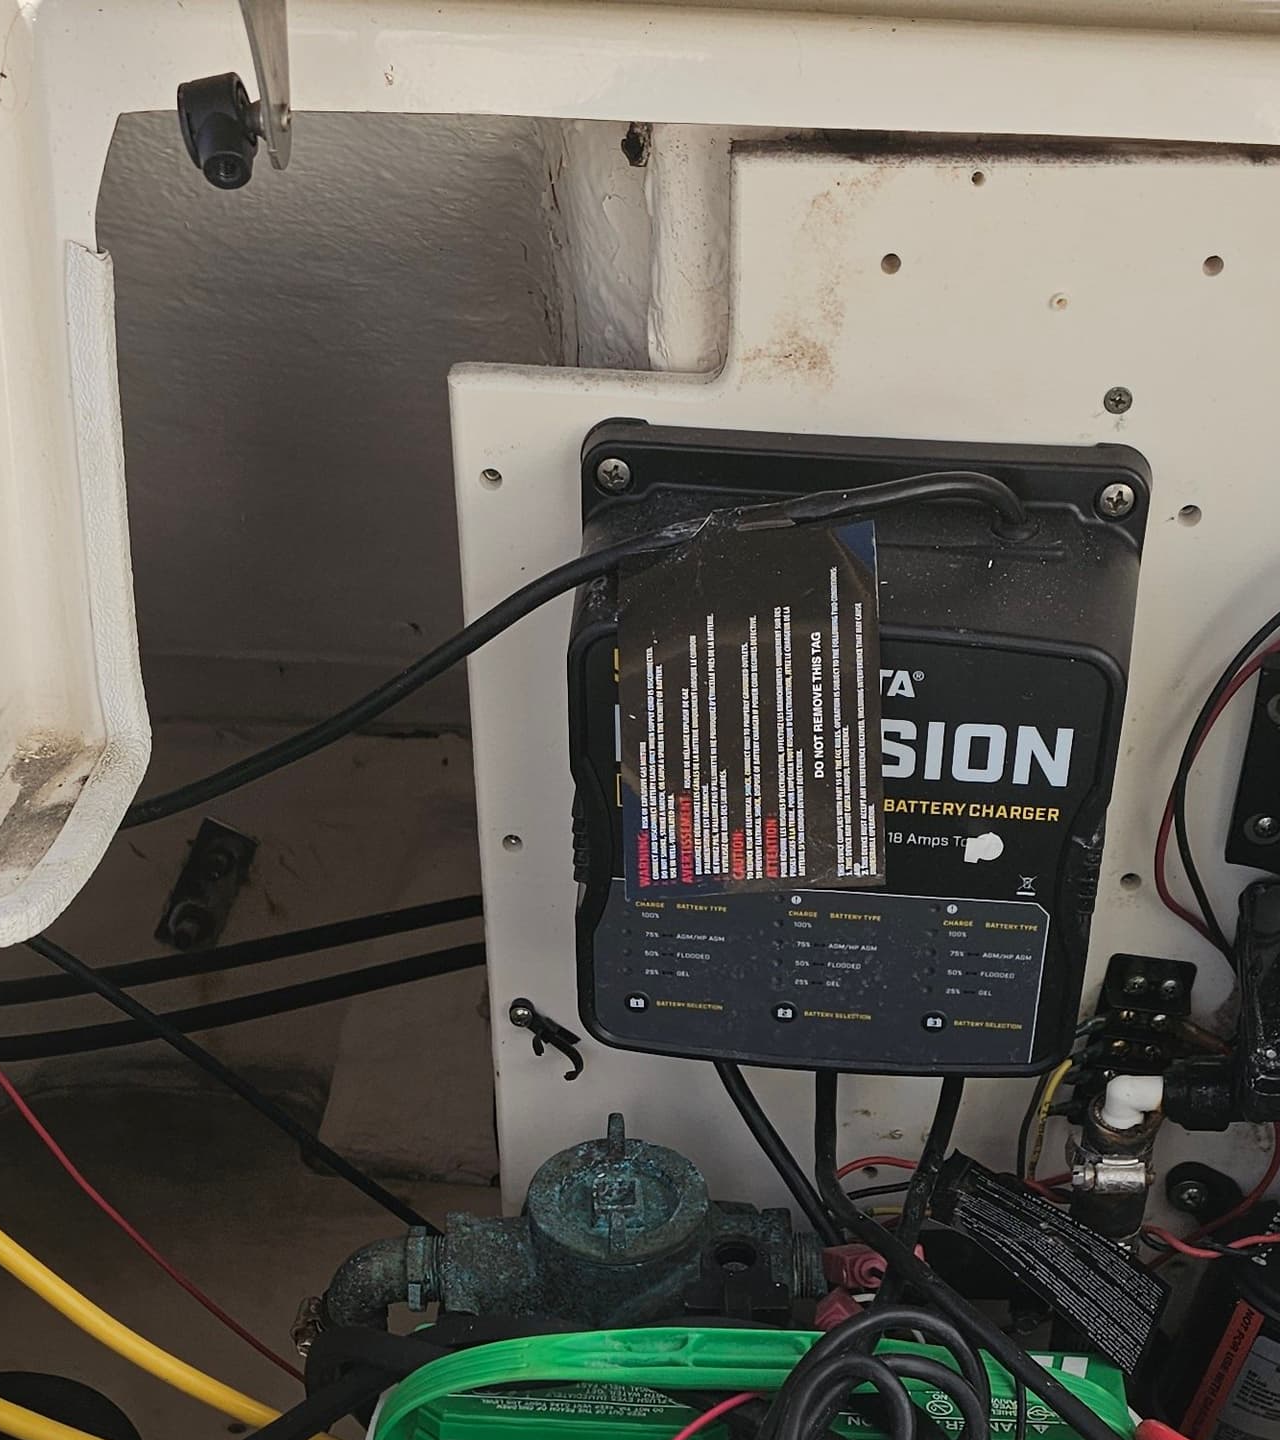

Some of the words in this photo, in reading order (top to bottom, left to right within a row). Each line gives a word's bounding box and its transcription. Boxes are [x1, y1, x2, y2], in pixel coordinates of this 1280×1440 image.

[810, 632, 822, 655] TAG
[811, 656, 822, 683] THIS
[811, 684, 823, 732] REMOVE
[814, 735, 824, 759] NOT
[814, 761, 824, 778] DO
[883, 799, 967, 816] BATTERY
[969, 803, 1060, 822] CHARGER
[888, 832, 903, 843] 18
[907, 832, 949, 848] Amps
[635, 901, 664, 909] CHARGE
[677, 904, 709, 912] BATTERY
[710, 905, 727, 913] TYPE
[789, 910, 818, 918] CHARGE
[830, 912, 863, 921] BATTERY
[864, 914, 881, 922] TYPE
[985, 922, 1018, 930] BATTERY
[1020, 924, 1038, 932] TYPE
[677, 952, 710, 960] FLOODED
[827, 962, 861, 970] FLOODED
[980, 971, 1015, 979] FLOODED
[953, 1020, 984, 1028] BATTERY
[984, 1022, 1022, 1030] SELECTION
[1240, 1309, 1255, 1331] NOT
